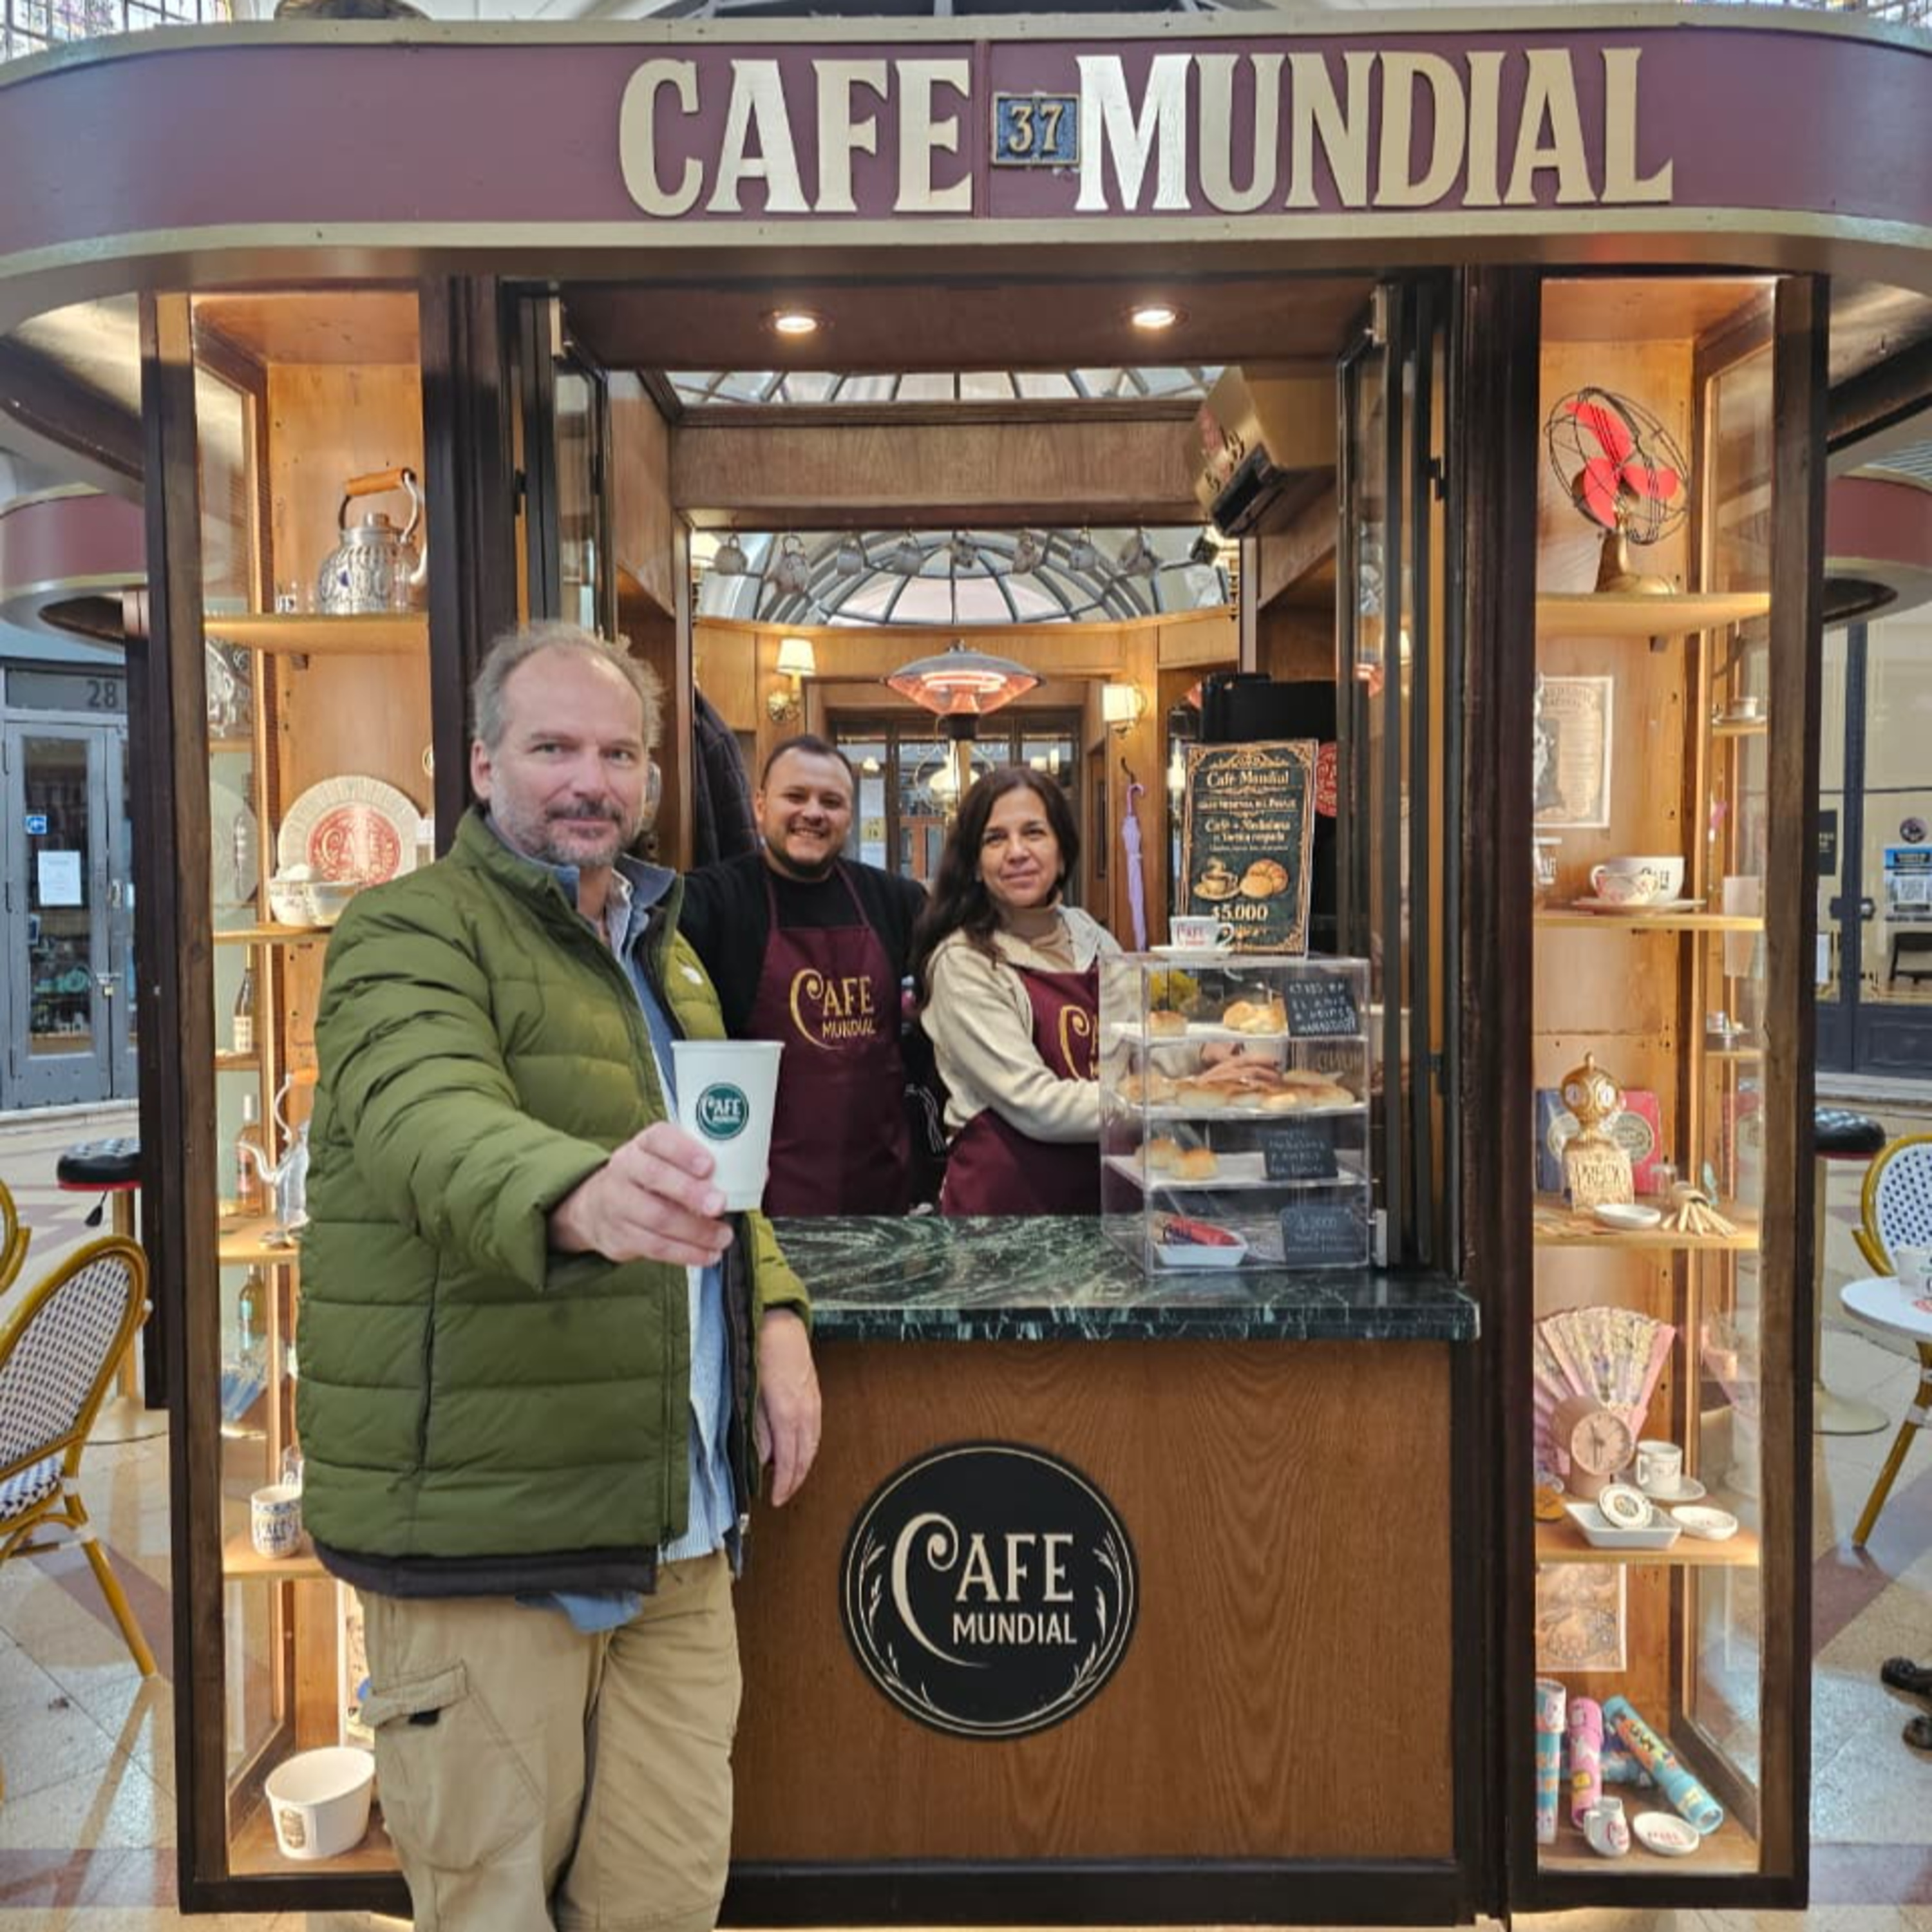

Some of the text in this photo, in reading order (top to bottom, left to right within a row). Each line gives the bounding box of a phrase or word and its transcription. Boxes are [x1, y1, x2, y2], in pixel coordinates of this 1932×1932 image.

[620, 48, 1673, 217] CAFE MUNDIAL
[1009, 103, 1064, 153] 37
[86, 680, 118, 708] 28
[790, 968, 875, 1050] CAFE
[701, 1095, 741, 1126] CAFE
[891, 1512, 1074, 1668] CAFE
[952, 1613, 1077, 1644] MUNDIAL
